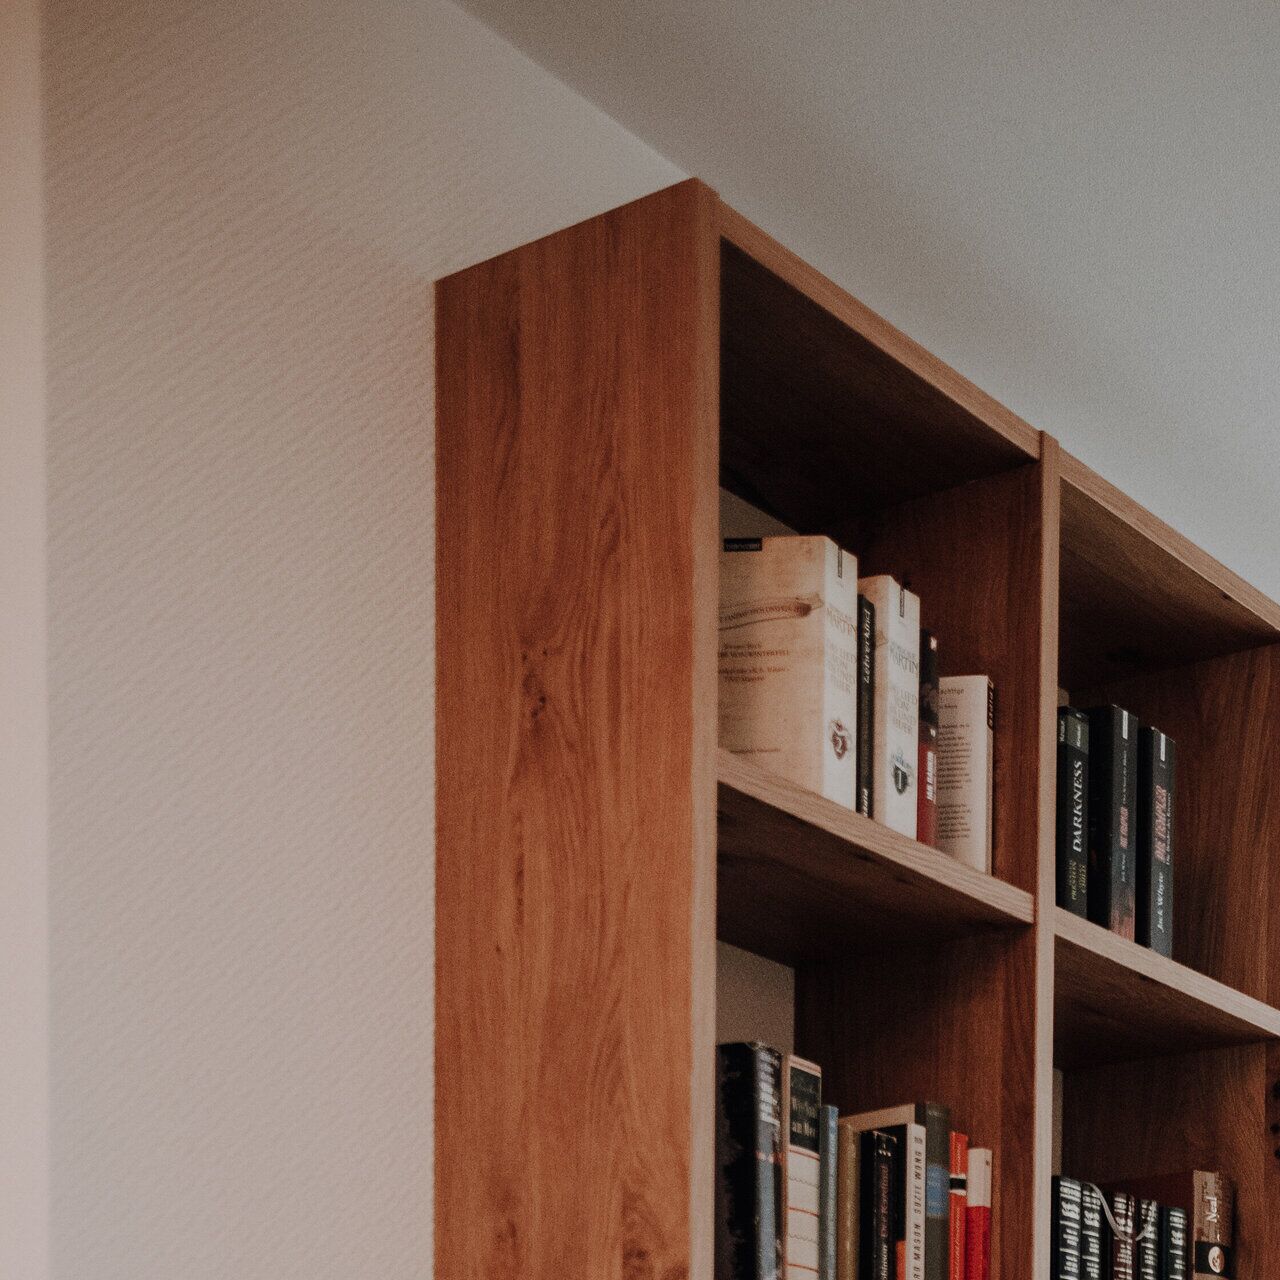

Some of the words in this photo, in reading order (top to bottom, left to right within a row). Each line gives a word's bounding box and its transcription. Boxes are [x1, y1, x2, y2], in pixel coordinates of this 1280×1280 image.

[826, 607, 857, 635] MARTIN
[863, 608, 871, 684] Lehrerkind
[888, 646, 918, 673] MARTIN
[1072, 759, 1084, 853] DARKNESS
[1154, 784, 1166, 839] TEMPLER
[1156, 871, 1165, 906] Whyte
[914, 1150, 923, 1181] WONG
[913, 1184, 921, 1215] SUZIE
[1205, 1195, 1219, 1223] Neal
[880, 1217, 889, 1238] Der
[913, 1223, 921, 1261] MASON
